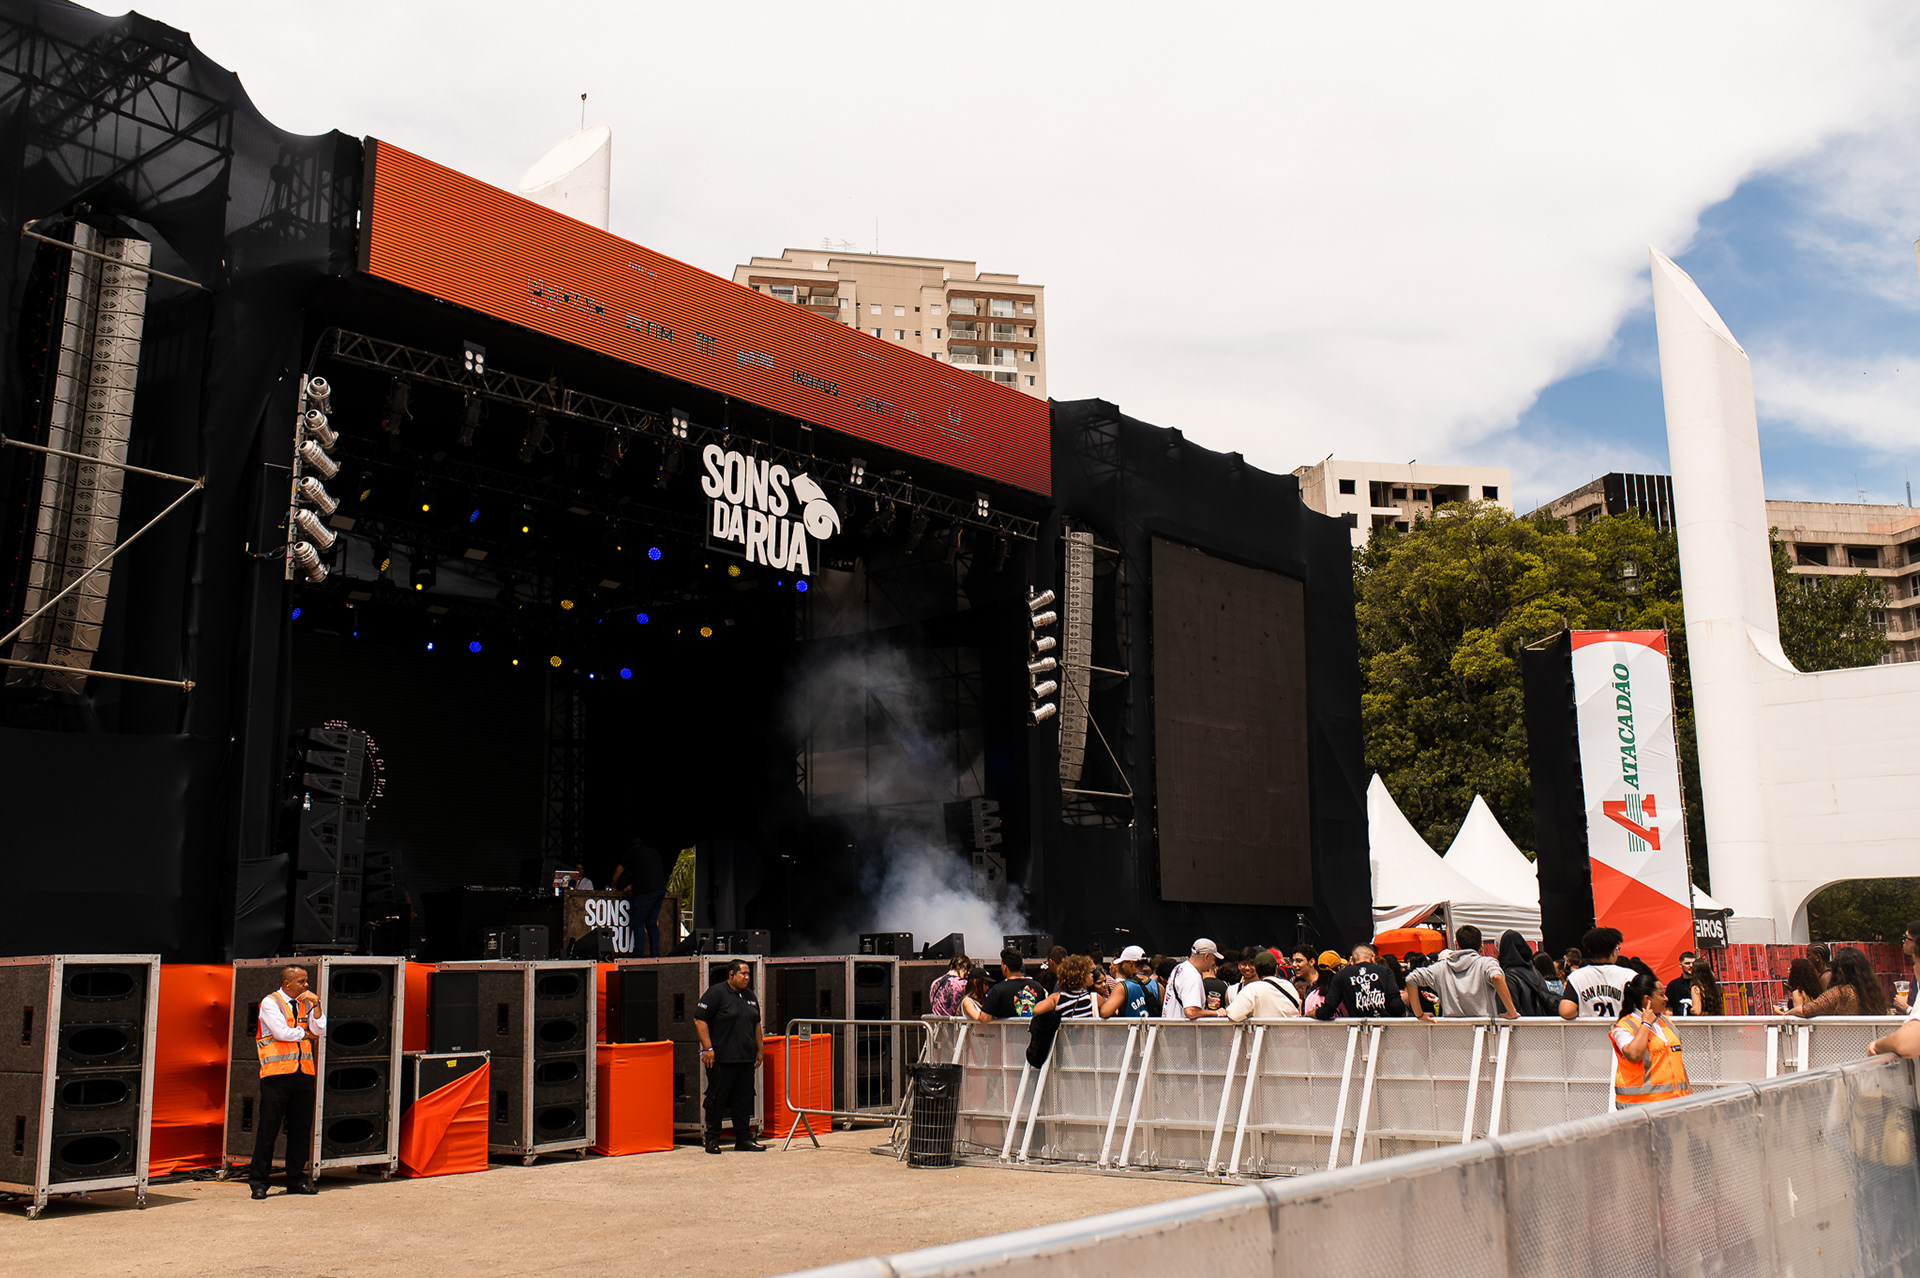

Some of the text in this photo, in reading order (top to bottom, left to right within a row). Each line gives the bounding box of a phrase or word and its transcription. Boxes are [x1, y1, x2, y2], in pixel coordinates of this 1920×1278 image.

[645, 320, 673, 343] TIM
[701, 444, 790, 517] SONS
[713, 500, 810, 576] DA RUA
[1611, 663, 1639, 790] ATACADÃO
[584, 899, 630, 927] SONS
[1582, 985, 1622, 1002] SAN ANTONIO
